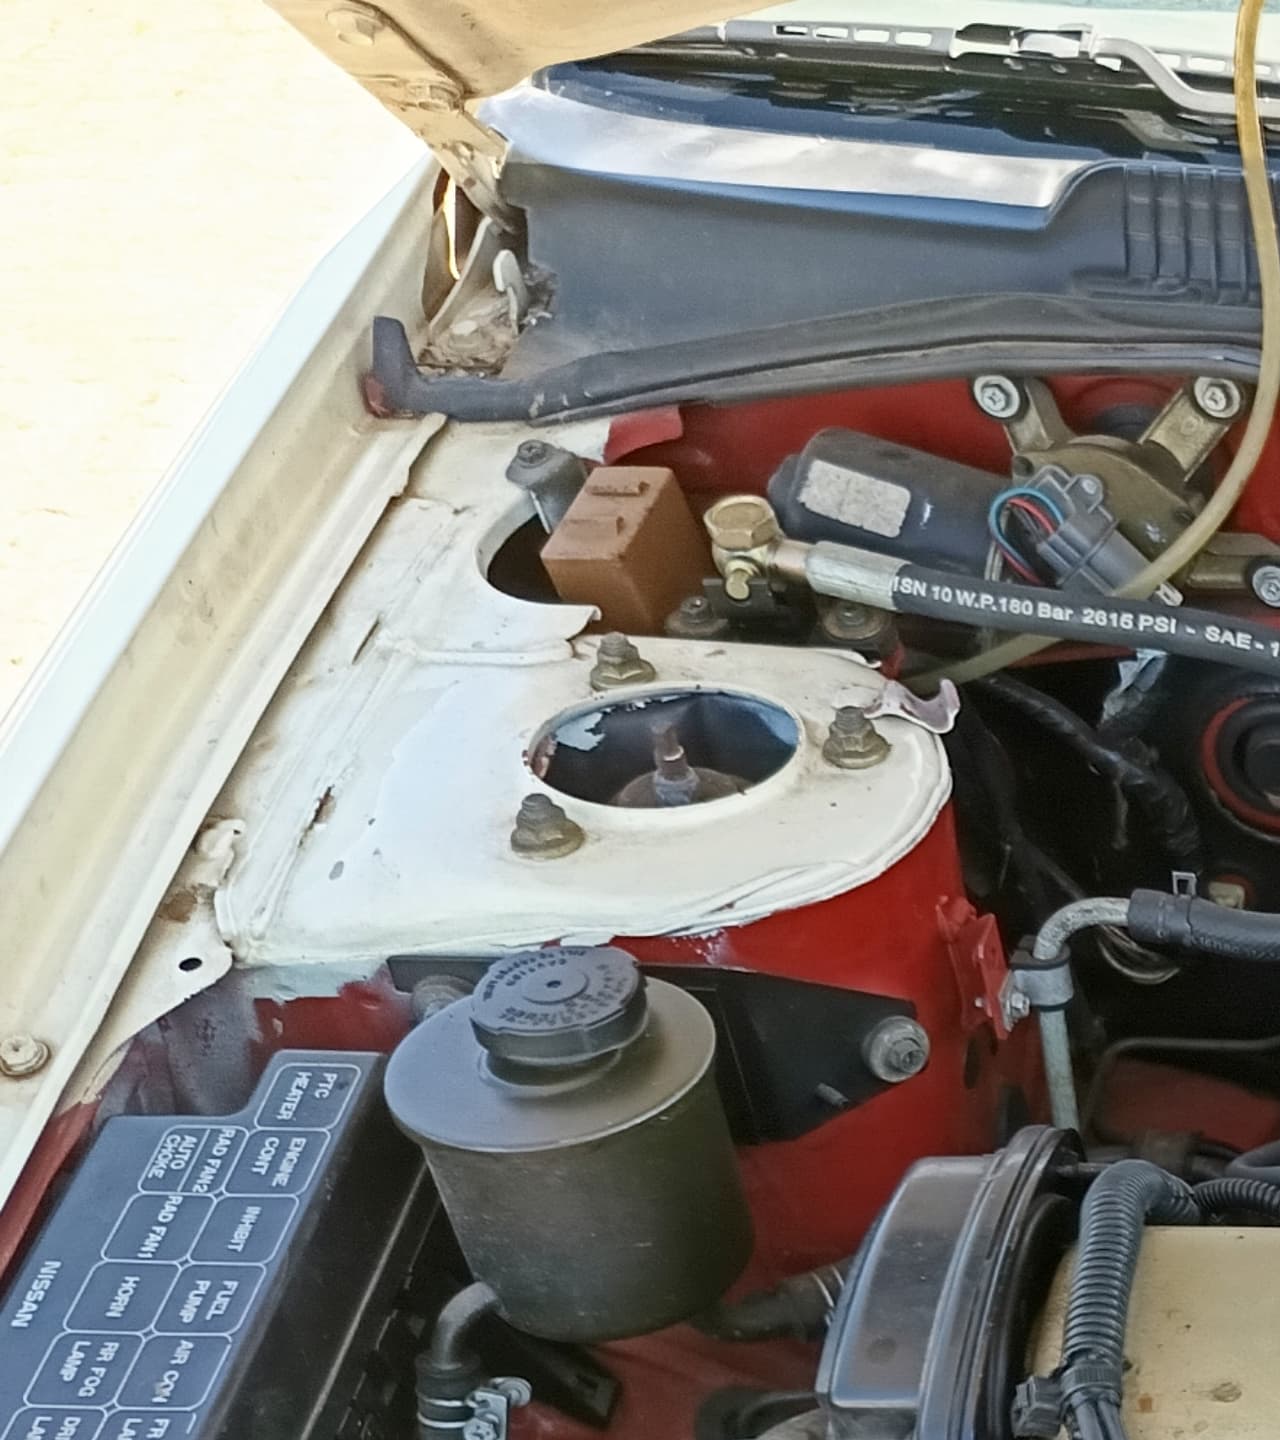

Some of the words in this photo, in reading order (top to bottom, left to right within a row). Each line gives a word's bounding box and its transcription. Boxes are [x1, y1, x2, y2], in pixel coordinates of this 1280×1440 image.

[931, 585, 953, 603] 10
[1037, 601, 1075, 622] Bar
[1137, 614, 1178, 635] PSI
[1205, 625, 1253, 650] SAE
[276, 1071, 313, 1121] HEATER
[314, 1072, 338, 1099] PTC
[147, 1134, 181, 1179] CHOKE
[170, 1134, 198, 1170] AUTO
[213, 1128, 237, 1157] RAD
[252, 1137, 280, 1175] CONT
[193, 1158, 222, 1194] FAN2
[271, 1137, 307, 1187] ENGINE
[157, 1194, 184, 1223] RAD
[137, 1226, 168, 1259] FAN1
[228, 1206, 262, 1252] INHIBIT
[11, 1260, 62, 1328] NISSAN
[105, 1276, 140, 1318] HORN
[179, 1280, 211, 1324] PUMP
[205, 1280, 238, 1321] FUEL
[59, 1341, 92, 1382] LAMP
[96, 1342, 120, 1362] RR
[170, 1339, 195, 1365] AIR
[78, 1367, 107, 1397] FOG
[151, 1370, 180, 1403] CON
[146, 1418, 171, 1439] FR
